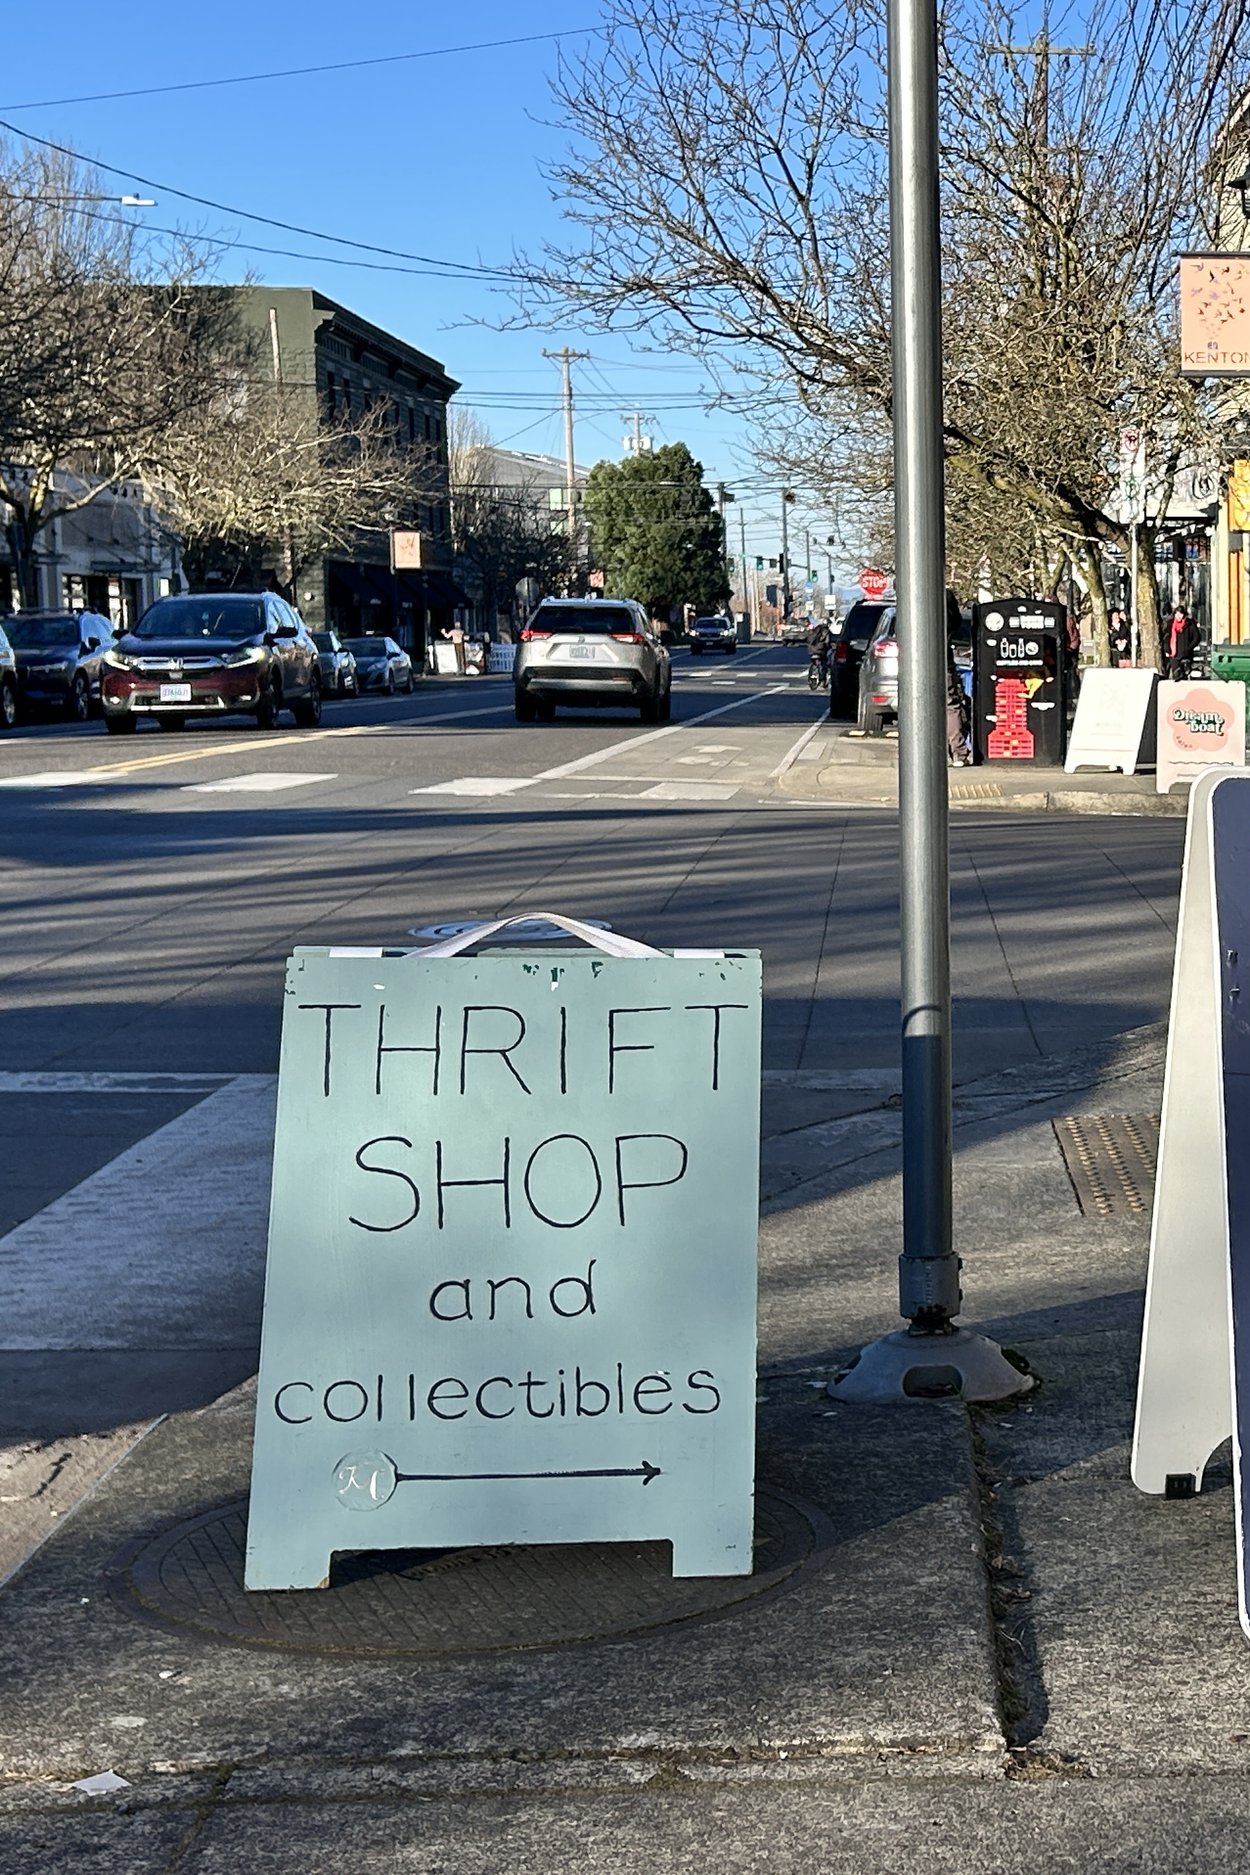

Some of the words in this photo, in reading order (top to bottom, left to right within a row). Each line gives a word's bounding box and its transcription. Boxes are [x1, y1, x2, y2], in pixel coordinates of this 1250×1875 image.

[862, 575, 886, 588] STOP
[1190, 720, 1225, 736] boat
[298, 1003, 749, 1097] THRIFT
[348, 1133, 689, 1232] SHOP
[429, 1258, 597, 1321] and
[274, 1362, 721, 1425] collectibles
